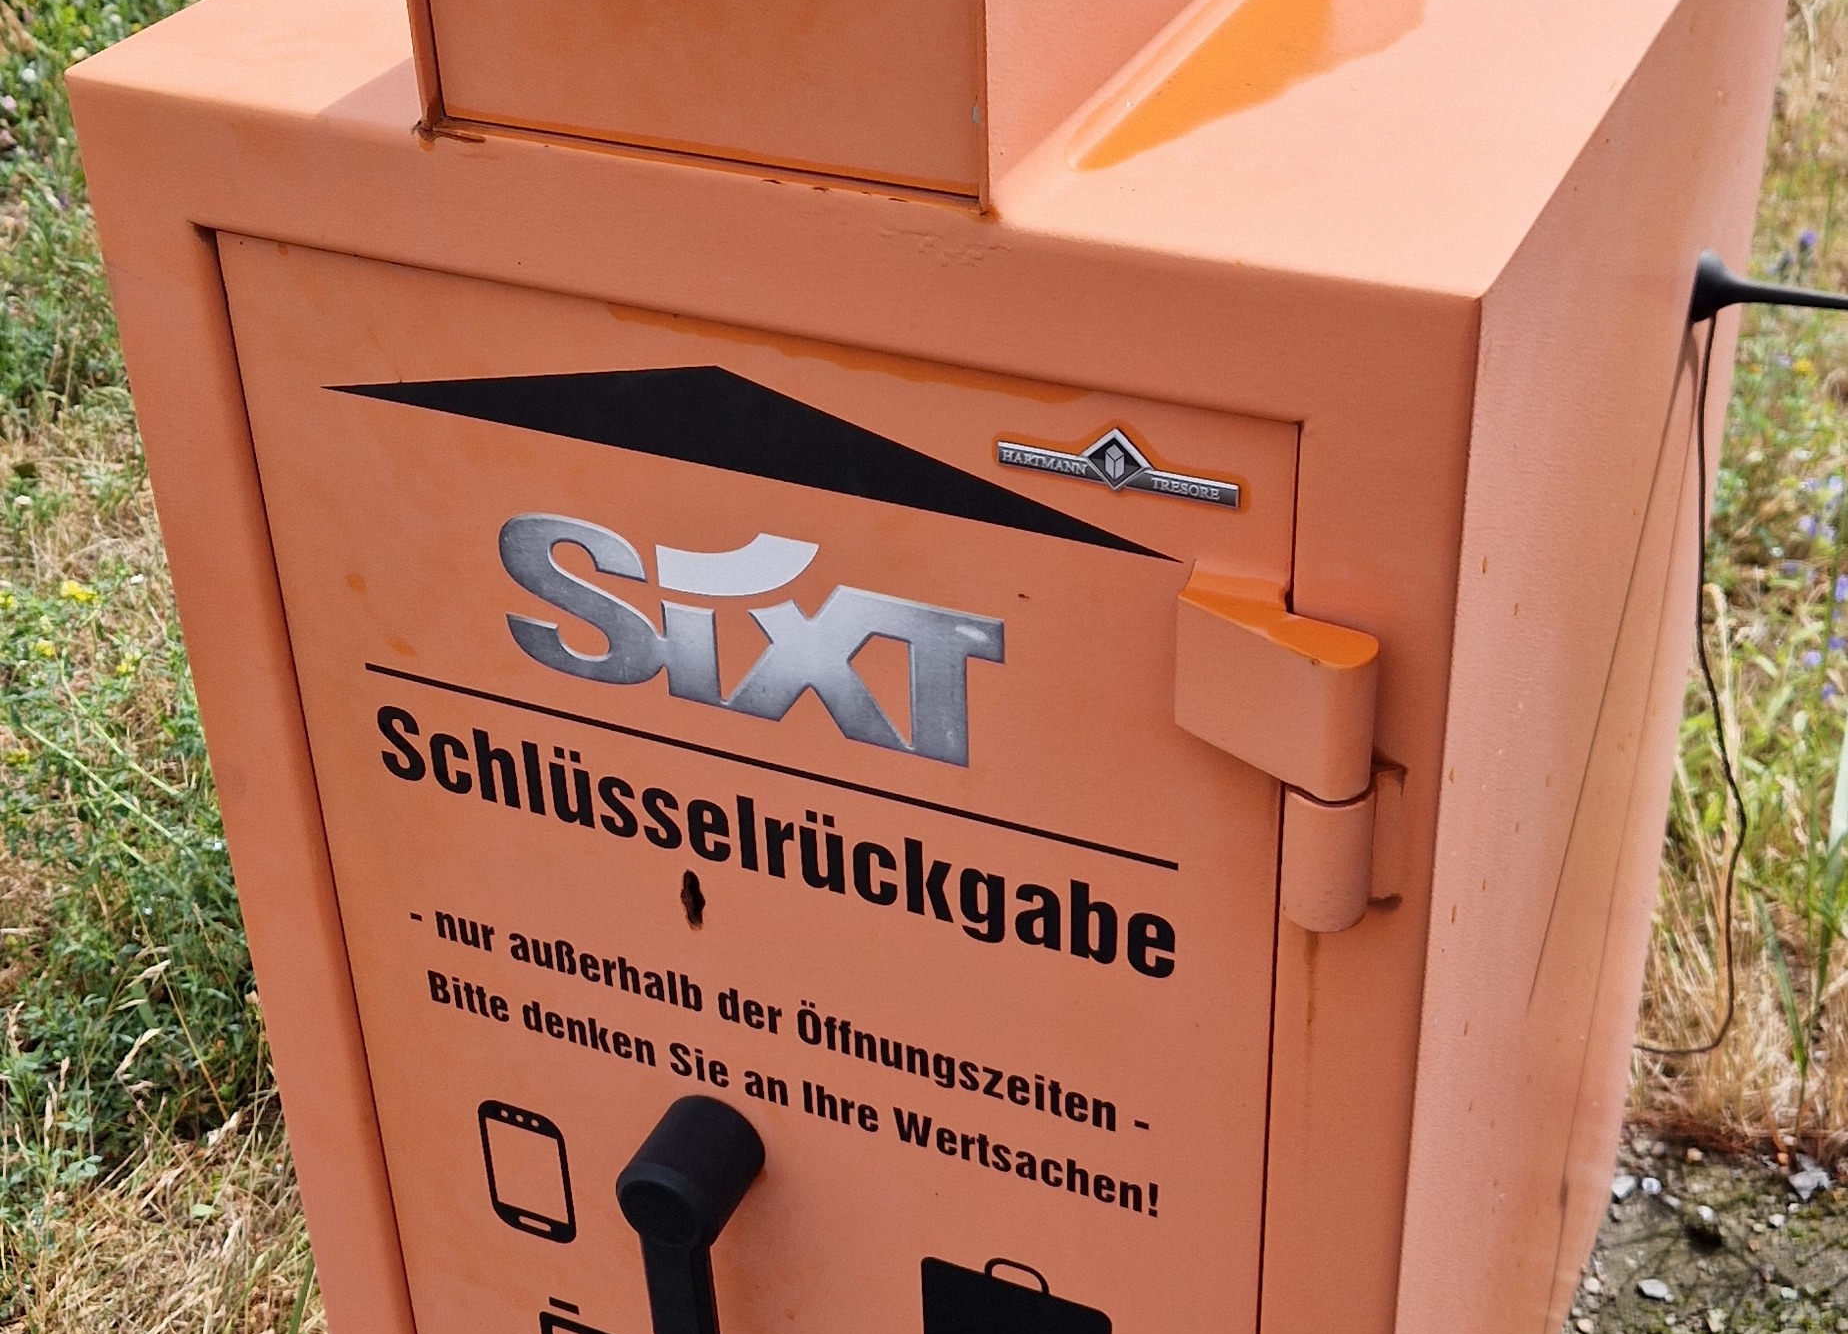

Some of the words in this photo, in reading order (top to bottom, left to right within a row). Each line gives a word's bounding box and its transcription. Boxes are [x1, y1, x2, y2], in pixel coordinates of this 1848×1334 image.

[1001, 449, 1088, 476] HARTMANN
[1151, 476, 1221, 501] TRESORE
[498, 512, 1006, 768] SIXT
[375, 704, 1177, 979] Schlüsselrückgabe
[427, 969, 511, 1023] Bitte
[522, 1000, 658, 1067] denken
[669, 1042, 731, 1089] Sie
[744, 1070, 790, 1108] an
[802, 1080, 880, 1134] Ihre
[892, 1106, 1160, 1218] Wertsachen!
[436, 910, 496, 953] nur
[508, 932, 703, 1014] außerhalb
[717, 986, 784, 1036] der
[796, 999, 1117, 1134] Öffnungszeiten
